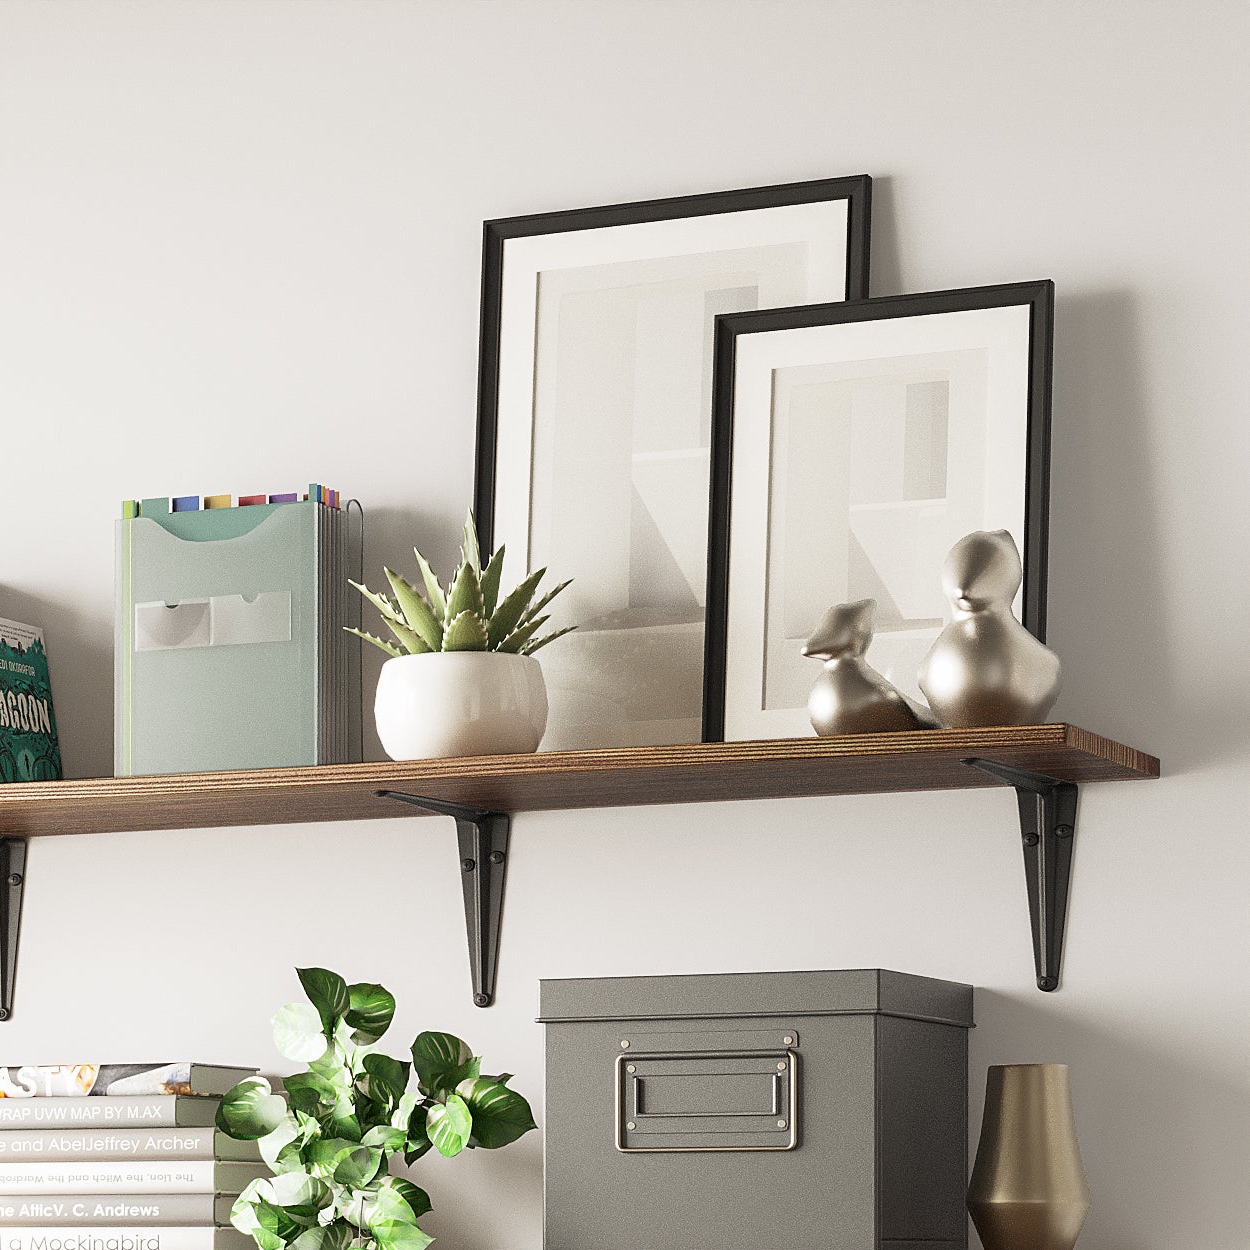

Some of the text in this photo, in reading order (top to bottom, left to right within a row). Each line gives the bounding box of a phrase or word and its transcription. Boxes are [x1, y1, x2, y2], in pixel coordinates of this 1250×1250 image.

[34, 1107, 67, 1120] UVW
[71, 1106, 101, 1119] MAP
[105, 1106, 123, 1119] BY
[11, 1137, 44, 1152] and
[144, 1135, 200, 1150] Archer
[47, 1174, 64, 1183] the
[67, 1174, 89, 1183] and
[92, 1173, 123, 1183] Witch
[126, 1174, 143, 1183] the
[146, 1172, 172, 1182] Lion,
[175, 1173, 194, 1182] The
[72, 1204, 89, 1217] C.
[93, 1203, 160, 1217] Andrews
[9, 1239, 22, 1250] a
